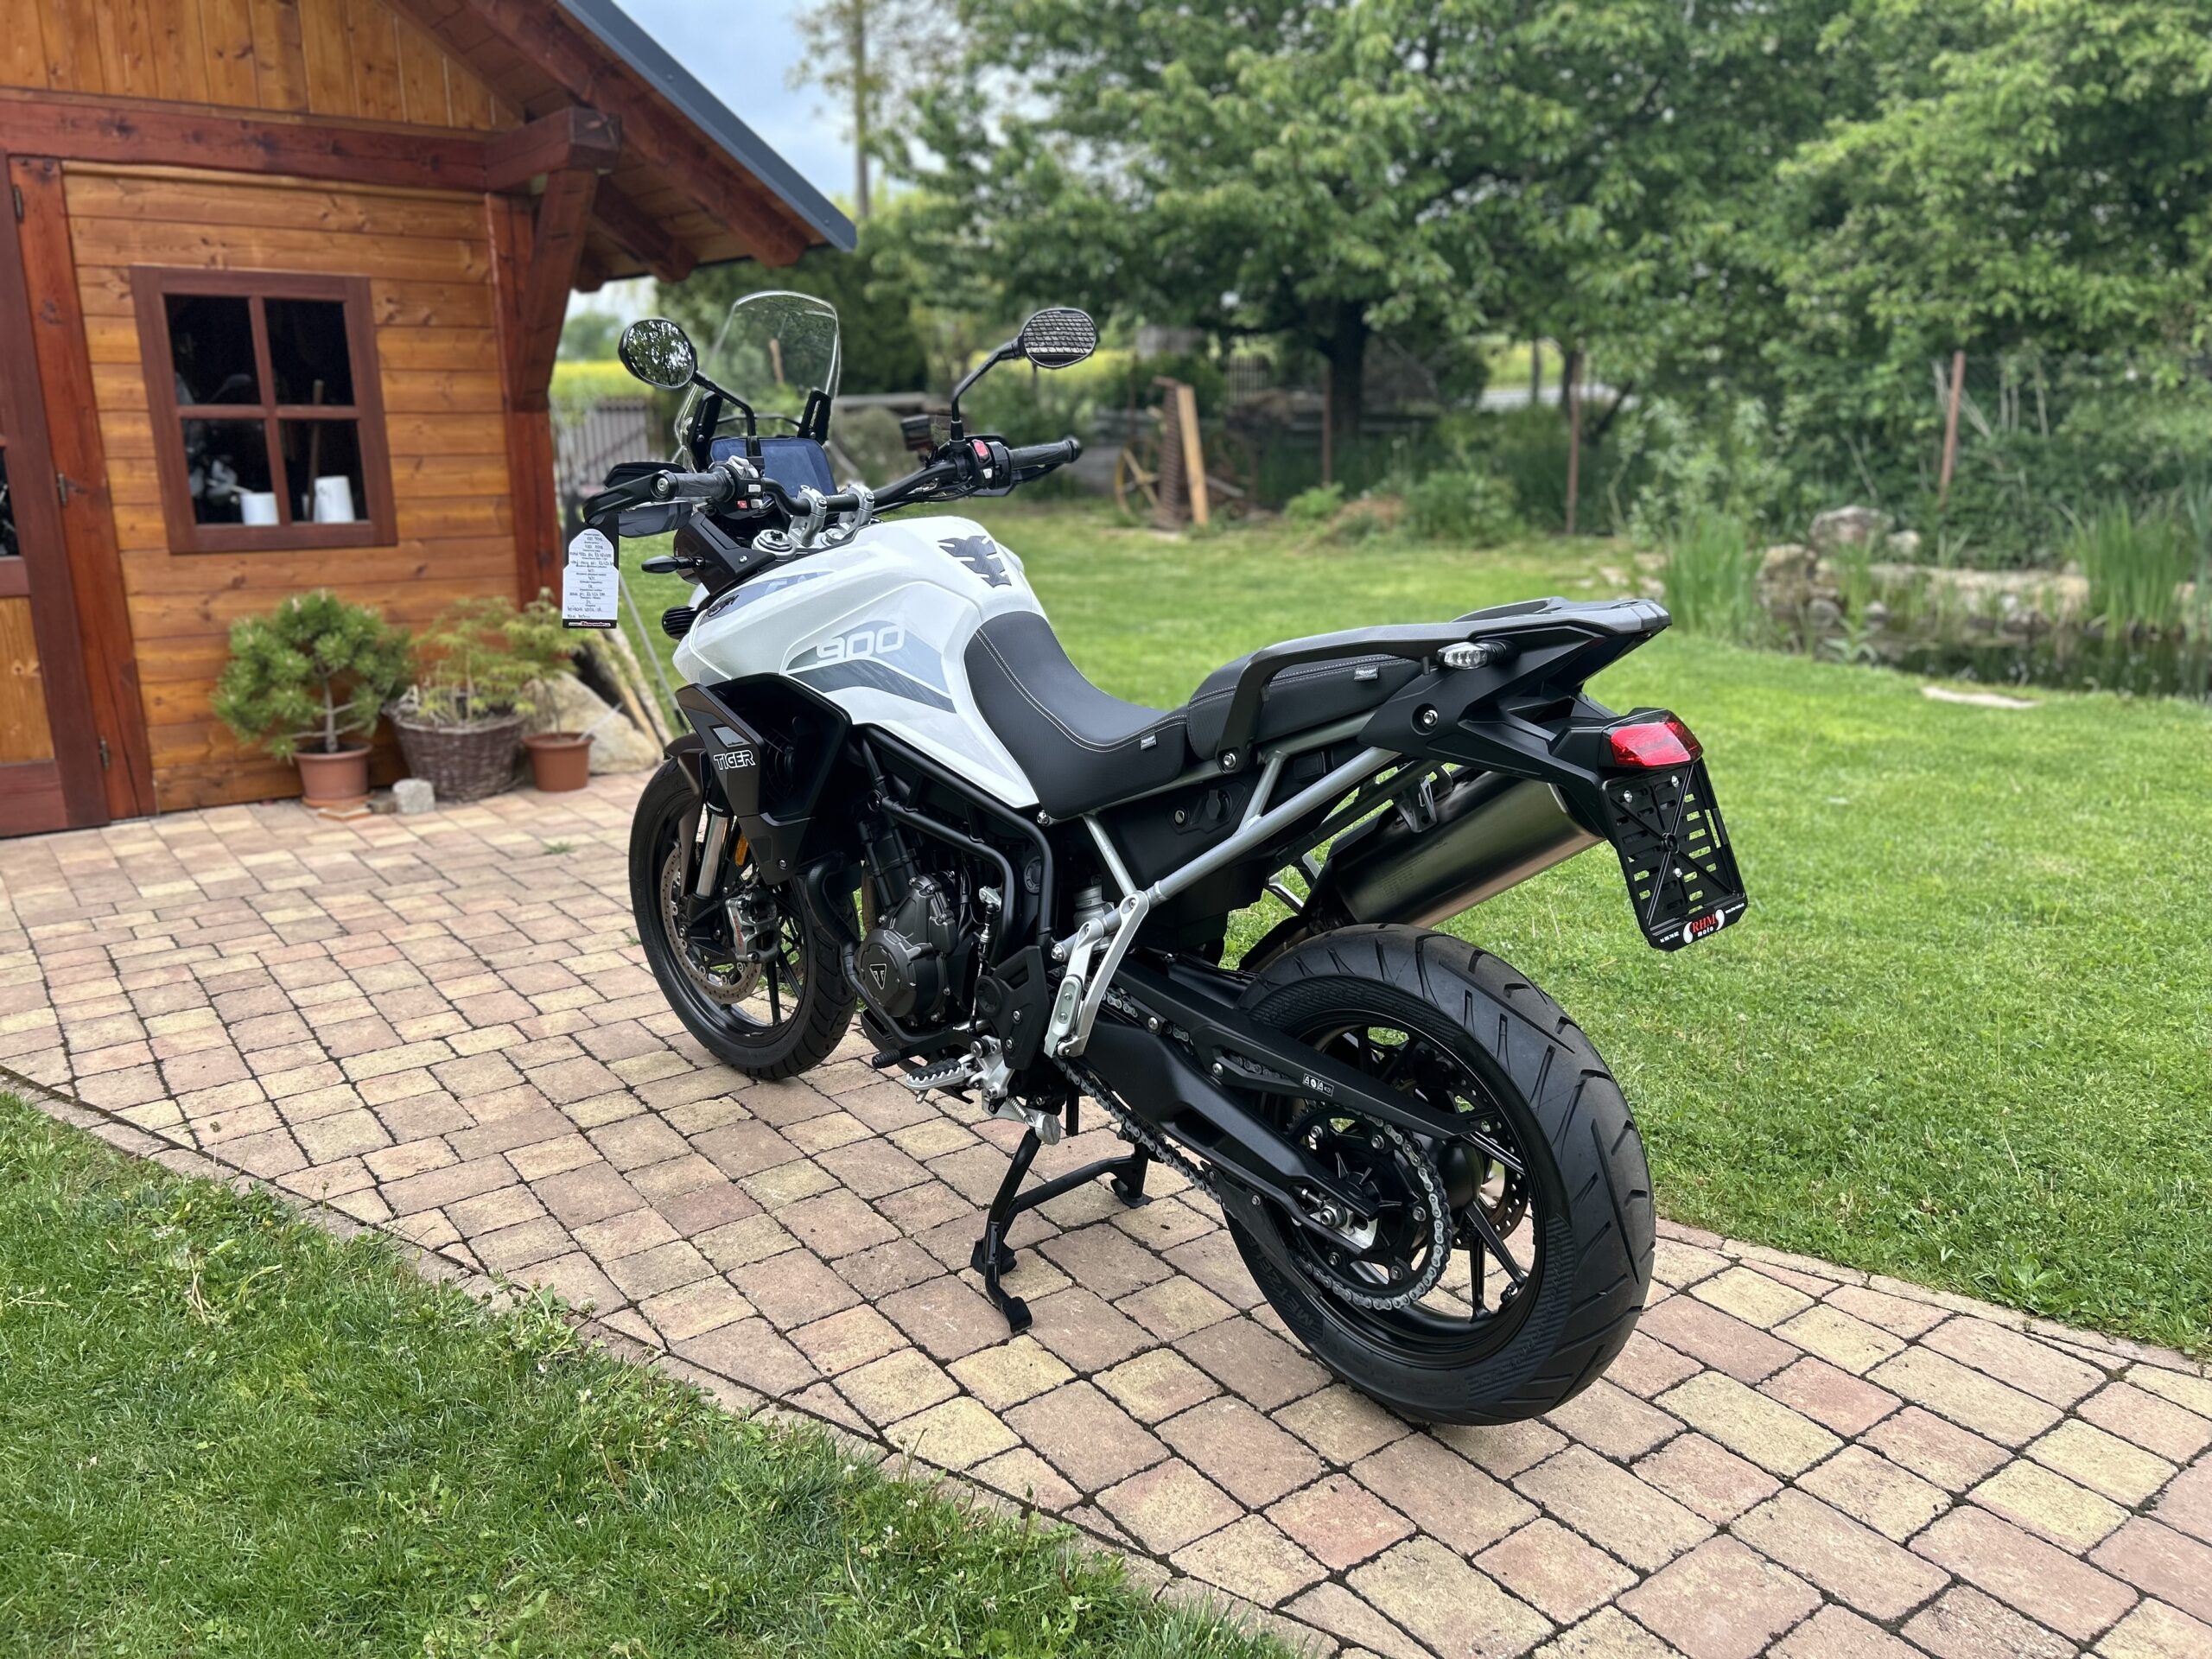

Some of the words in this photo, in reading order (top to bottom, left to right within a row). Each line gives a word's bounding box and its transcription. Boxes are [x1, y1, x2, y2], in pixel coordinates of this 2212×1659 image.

[817, 625, 905, 664] 900
[714, 749, 755, 770] TIGER
[1693, 913, 1716, 933] RHM
[1697, 925, 1714, 938] moto
